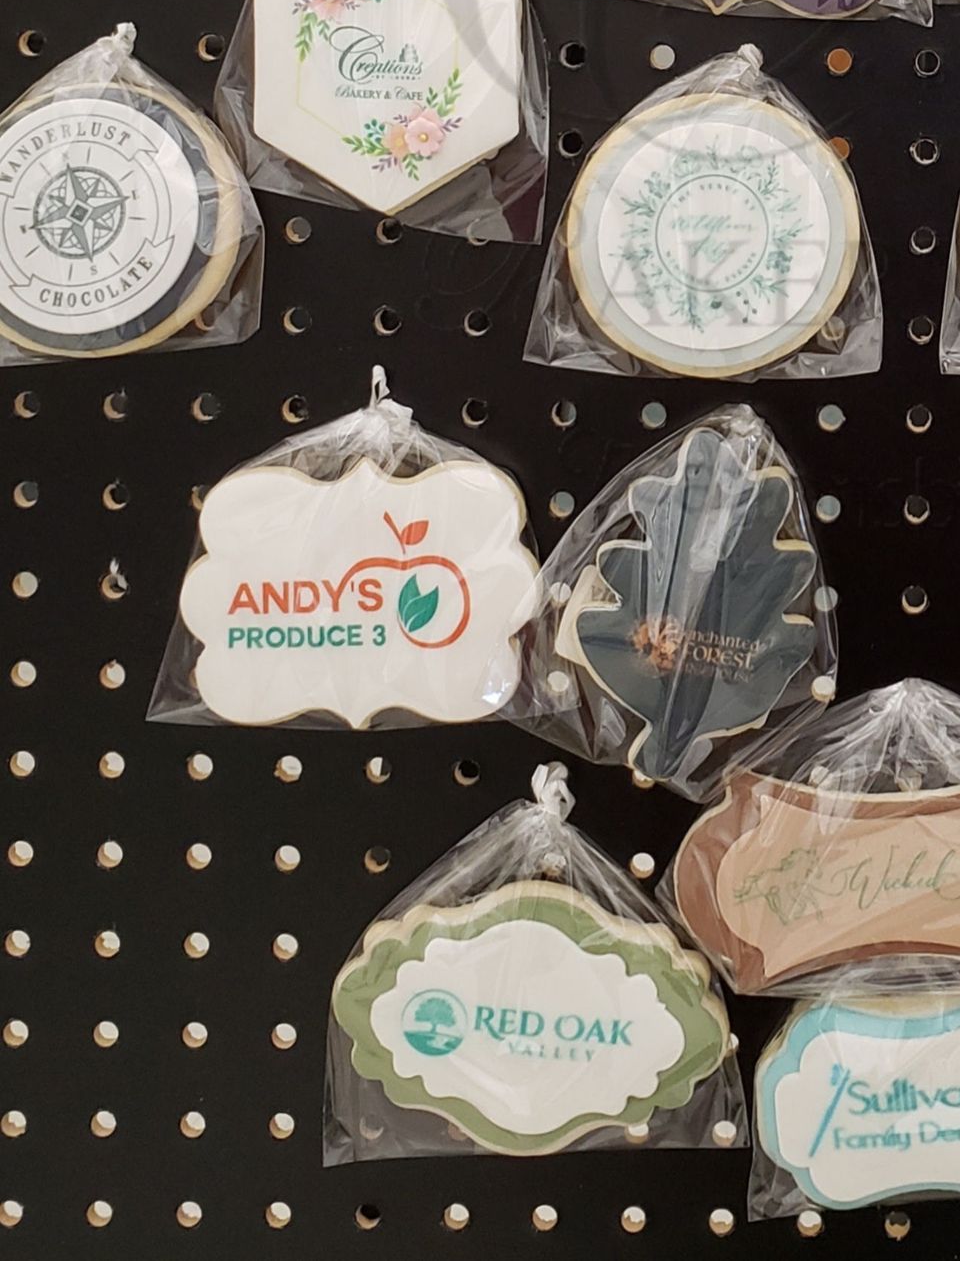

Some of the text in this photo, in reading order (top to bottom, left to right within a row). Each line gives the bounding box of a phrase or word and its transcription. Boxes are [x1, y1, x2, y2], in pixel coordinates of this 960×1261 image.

[328, 25, 424, 85] Creations
[39, 255, 153, 309] CHOCOLATE
[227, 577, 384, 616] ANDY'S
[228, 624, 386, 649] PRODUCE 3
[474, 1005, 634, 1046] RED OAK
[508, 1042, 596, 1062] VALLEY
[833, 1126, 912, 1150] Family
